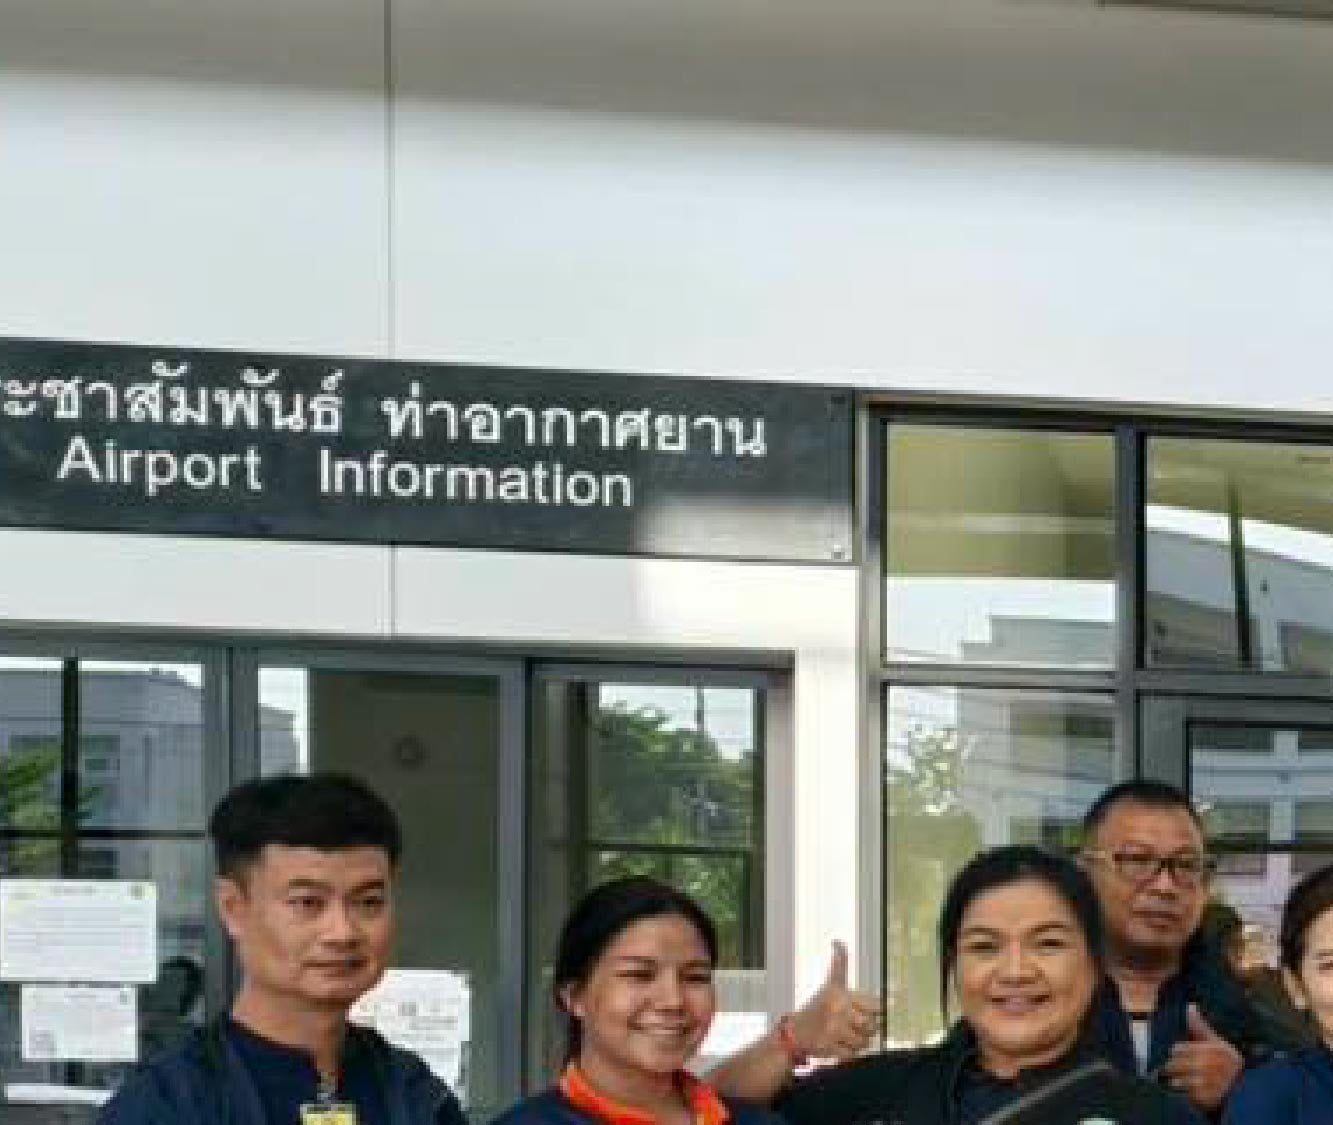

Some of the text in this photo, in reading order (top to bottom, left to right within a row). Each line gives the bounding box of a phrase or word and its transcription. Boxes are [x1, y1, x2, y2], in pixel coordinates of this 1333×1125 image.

[0, 359, 767, 458] ะชาสัมพันธ์ ท่าอากาศยาน
[56, 435, 633, 507] Airport Information
